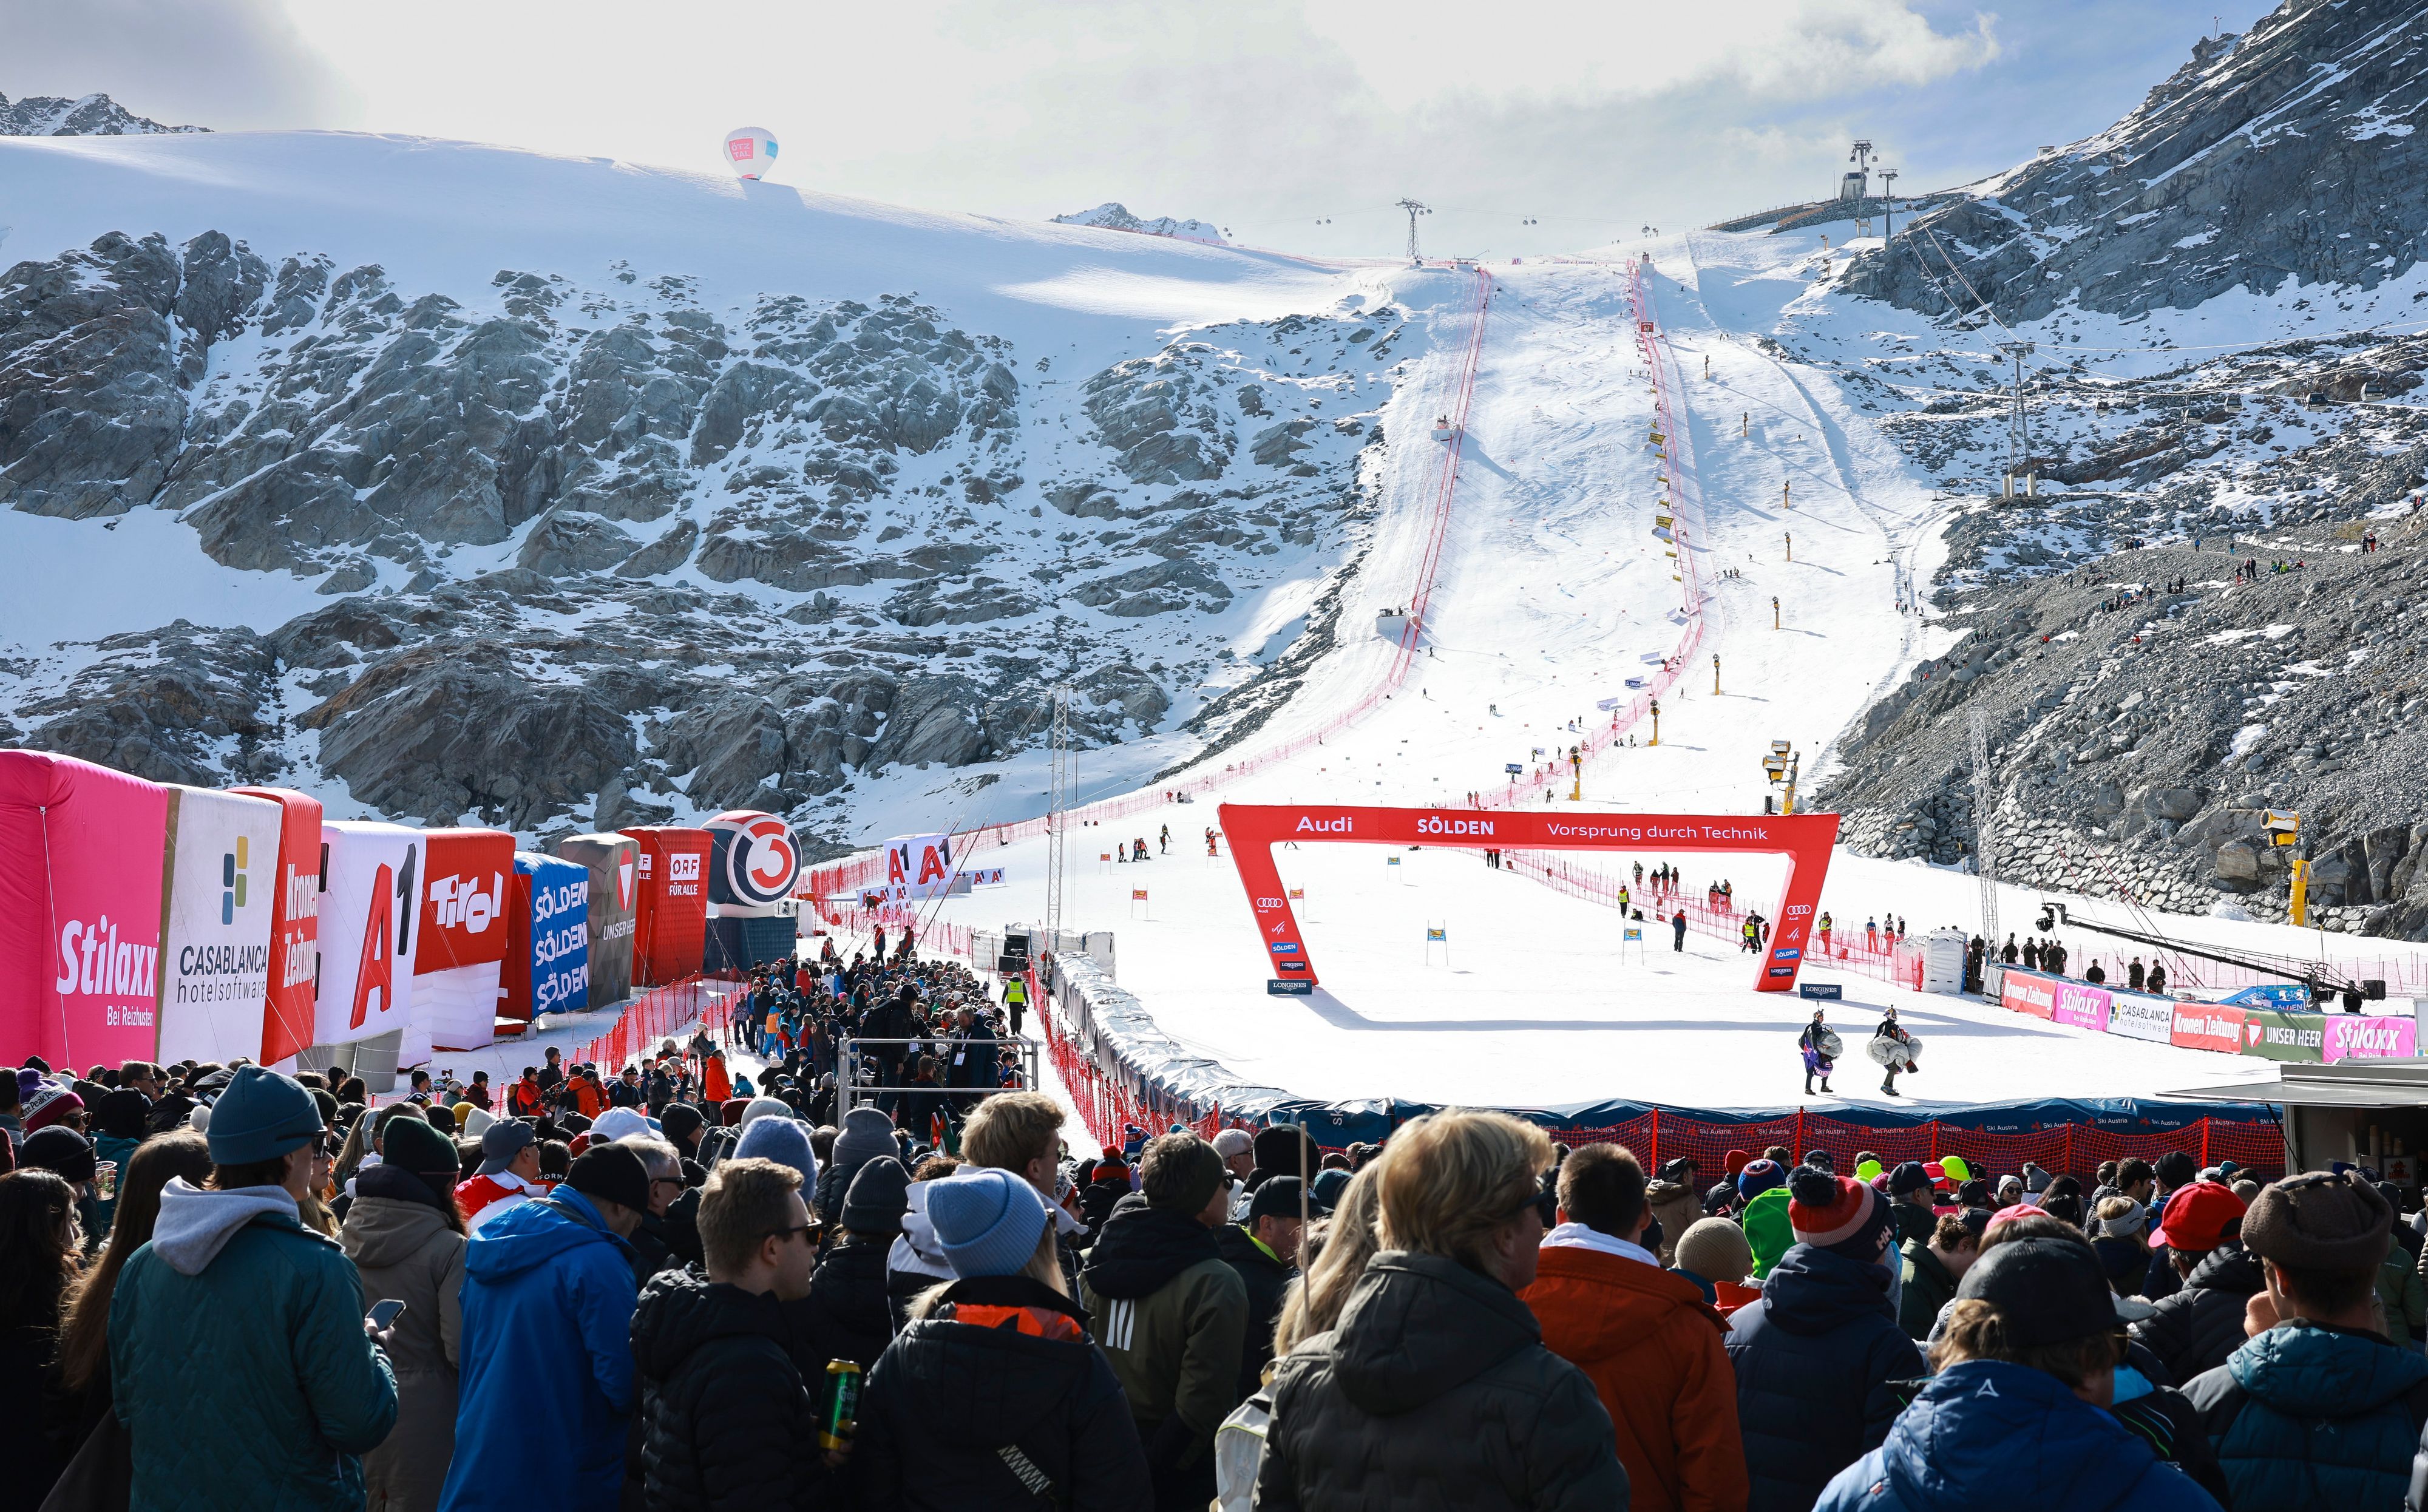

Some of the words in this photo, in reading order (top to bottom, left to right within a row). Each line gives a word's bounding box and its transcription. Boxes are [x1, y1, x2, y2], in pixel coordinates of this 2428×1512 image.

[731, 142, 750, 151] ÖTZ
[1295, 816, 1352, 832] Audi
[1417, 816, 1494, 835] SÖLDEN
[1547, 823, 1641, 840] Vorsprung
[1646, 826, 1697, 838] durch
[1701, 826, 1768, 839] Technik
[673, 859, 698, 875] ORF
[889, 843, 909, 885] A1
[918, 838, 951, 885] A1
[669, 882, 682, 896] FÜR
[683, 884, 698, 895] ALLE
[974, 870, 985, 884] A1
[991, 869, 1002, 883] A1
[285, 863, 319, 921] Kronen
[429, 870, 503, 934] Tirol
[535, 880, 588, 923] SÖLDEN
[350, 842, 416, 1030] A1
[535, 921, 588, 967] SÖLDEN
[603, 921, 626, 941] UNSER
[56, 914, 158, 997] Stilaxx
[180, 945, 266, 976] CASABLANCA
[283, 927, 317, 988] Zeitung
[1776, 949, 1797, 958] SÖLDEN
[177, 975, 265, 1003] hotelsoftware
[537, 963, 588, 1010] SÖLDEN
[2004, 978, 2027, 1000] Kronen
[2026, 985, 2053, 1011] Zeitung
[107, 1005, 120, 1026] Bei
[122, 1005, 153, 1026] Reizhusten
[2060, 988, 2103, 1017] Stilaxx
[2121, 1005, 2170, 1023] CASABLANCA
[2120, 1017, 2169, 1034] hotelsoftware
[2174, 1012, 2205, 1034] Kronen
[2205, 1015, 2241, 1043] Zeitung
[2267, 1026, 2295, 1045] UNSER
[2297, 1029, 2321, 1048] HEER
[2335, 1020, 2401, 1051] Stilaxx
[30, 1094, 47, 1110] Peak
[1876, 1225, 1893, 1251] HH
